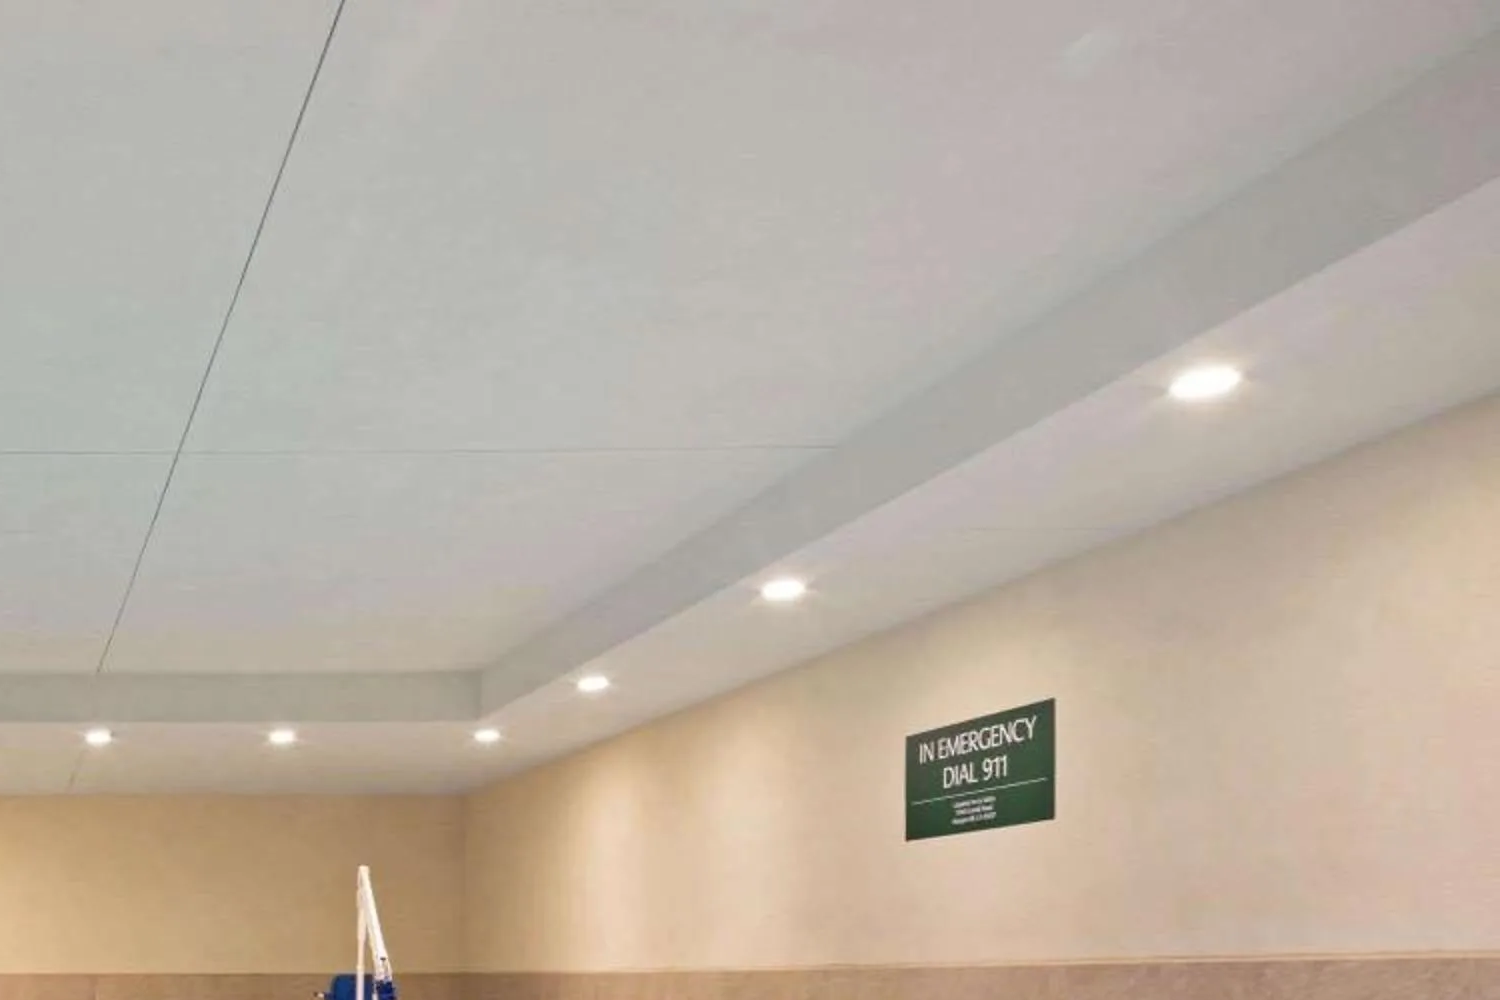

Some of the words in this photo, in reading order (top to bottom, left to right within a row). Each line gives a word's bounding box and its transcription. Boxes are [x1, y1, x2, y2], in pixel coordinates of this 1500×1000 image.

[918, 740, 935, 765] IN
[938, 714, 1038, 760] EMERGENCY
[942, 761, 979, 789] DIAL
[982, 754, 1008, 781] 911
